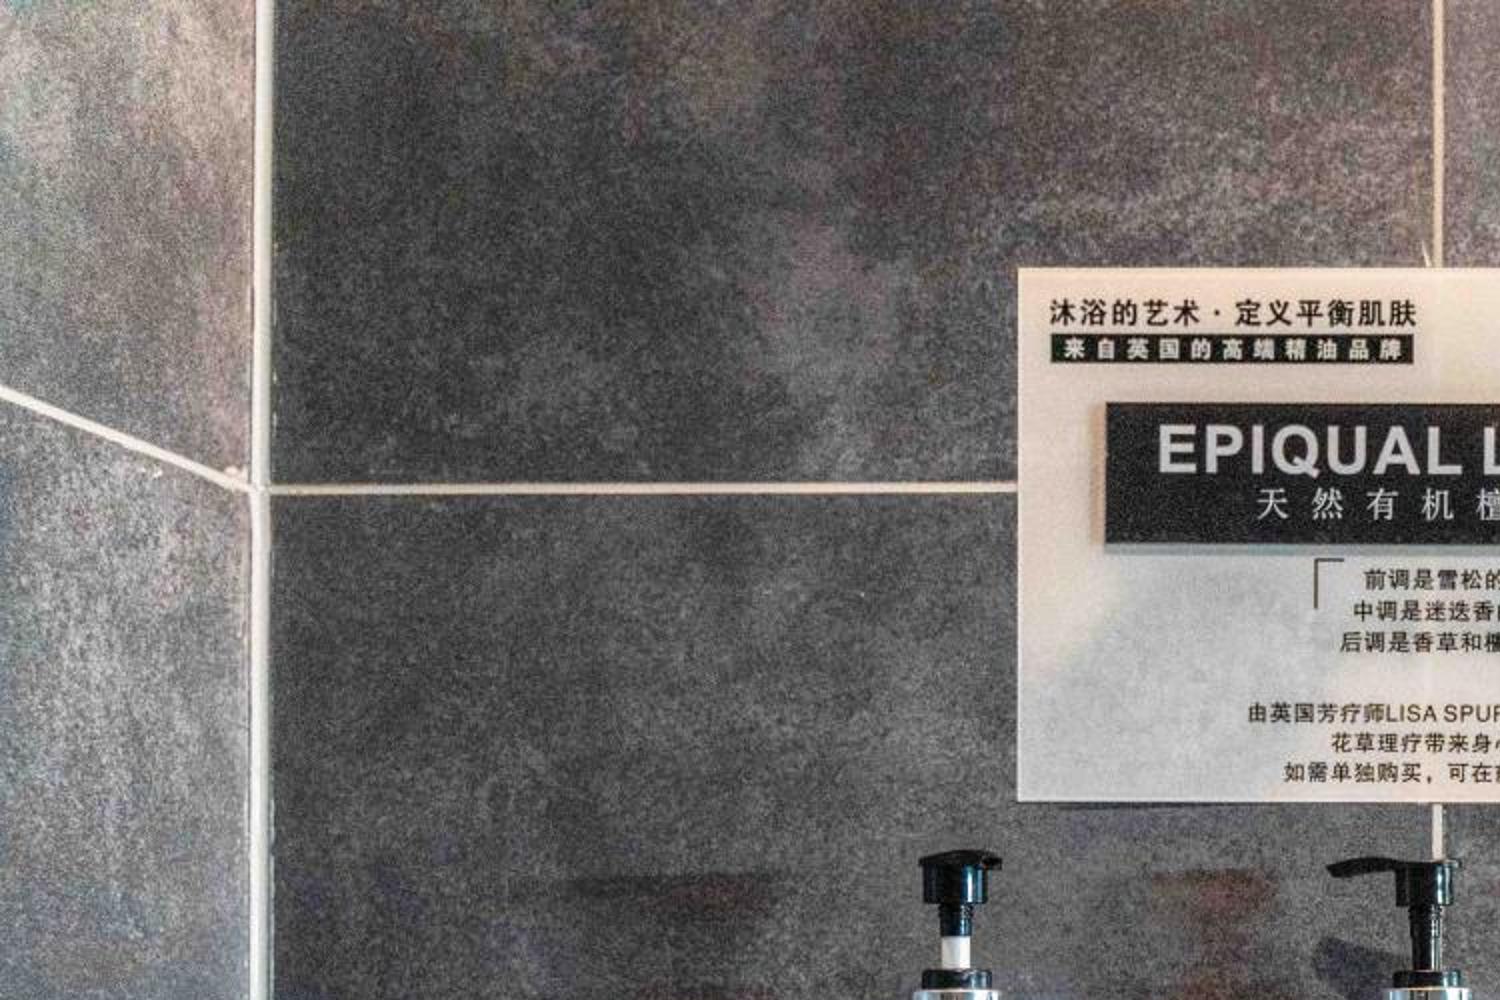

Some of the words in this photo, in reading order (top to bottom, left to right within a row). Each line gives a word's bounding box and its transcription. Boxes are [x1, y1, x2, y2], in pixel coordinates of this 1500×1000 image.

[1064, 338, 1402, 361] 来自英国的高端精油品牌
[1158, 424, 1463, 479] EPIQUAL
